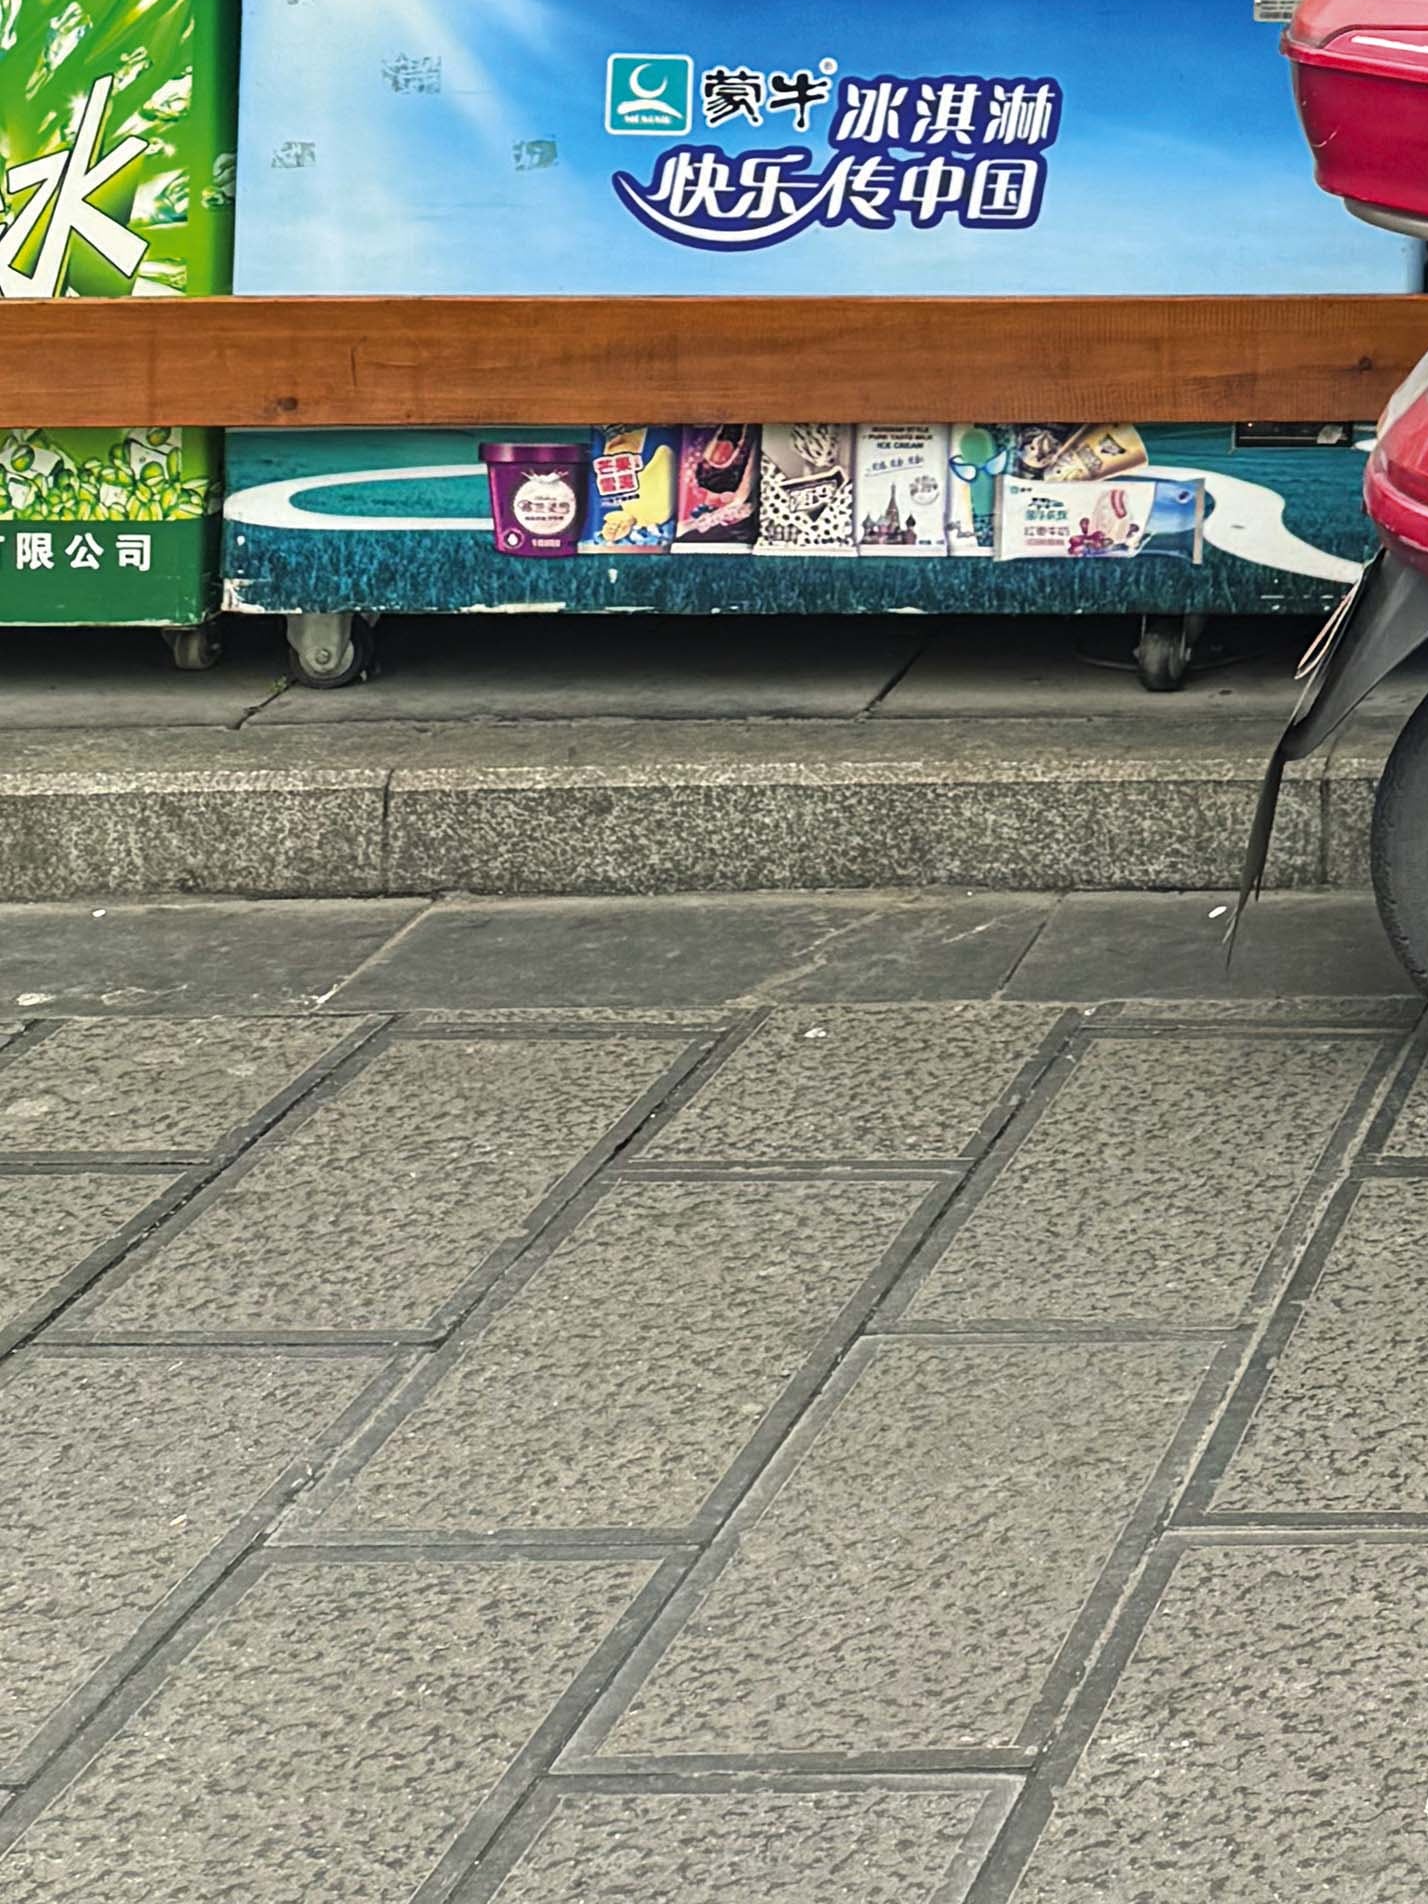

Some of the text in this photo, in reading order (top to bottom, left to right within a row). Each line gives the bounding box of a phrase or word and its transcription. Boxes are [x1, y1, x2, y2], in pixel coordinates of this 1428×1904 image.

[703, 69, 1056, 145] 蒙牛 冰淇淋
[645, 151, 1039, 222] 快乐传中国
[0, 532, 152, 572] 限公司
